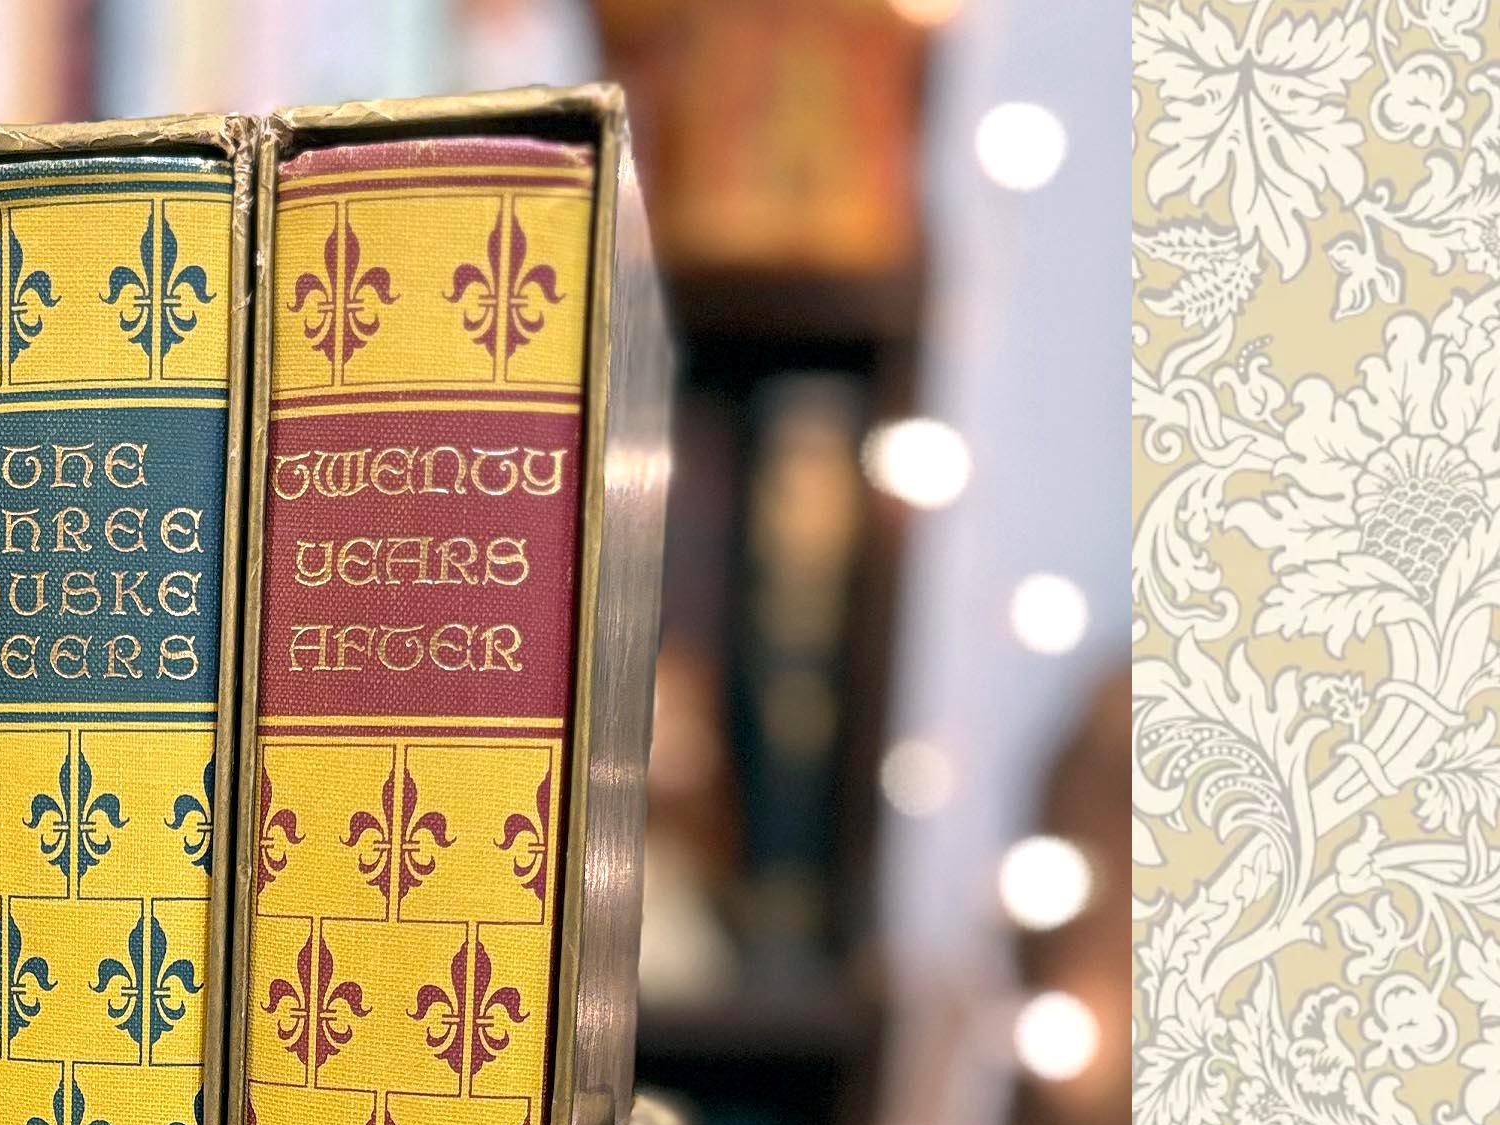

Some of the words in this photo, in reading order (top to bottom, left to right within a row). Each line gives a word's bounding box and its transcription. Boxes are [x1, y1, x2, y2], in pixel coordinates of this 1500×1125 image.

[2, 442, 148, 489] THE
[272, 446, 568, 500] TWENTY
[294, 537, 530, 587] YEARS
[288, 624, 523, 672] AFTER
